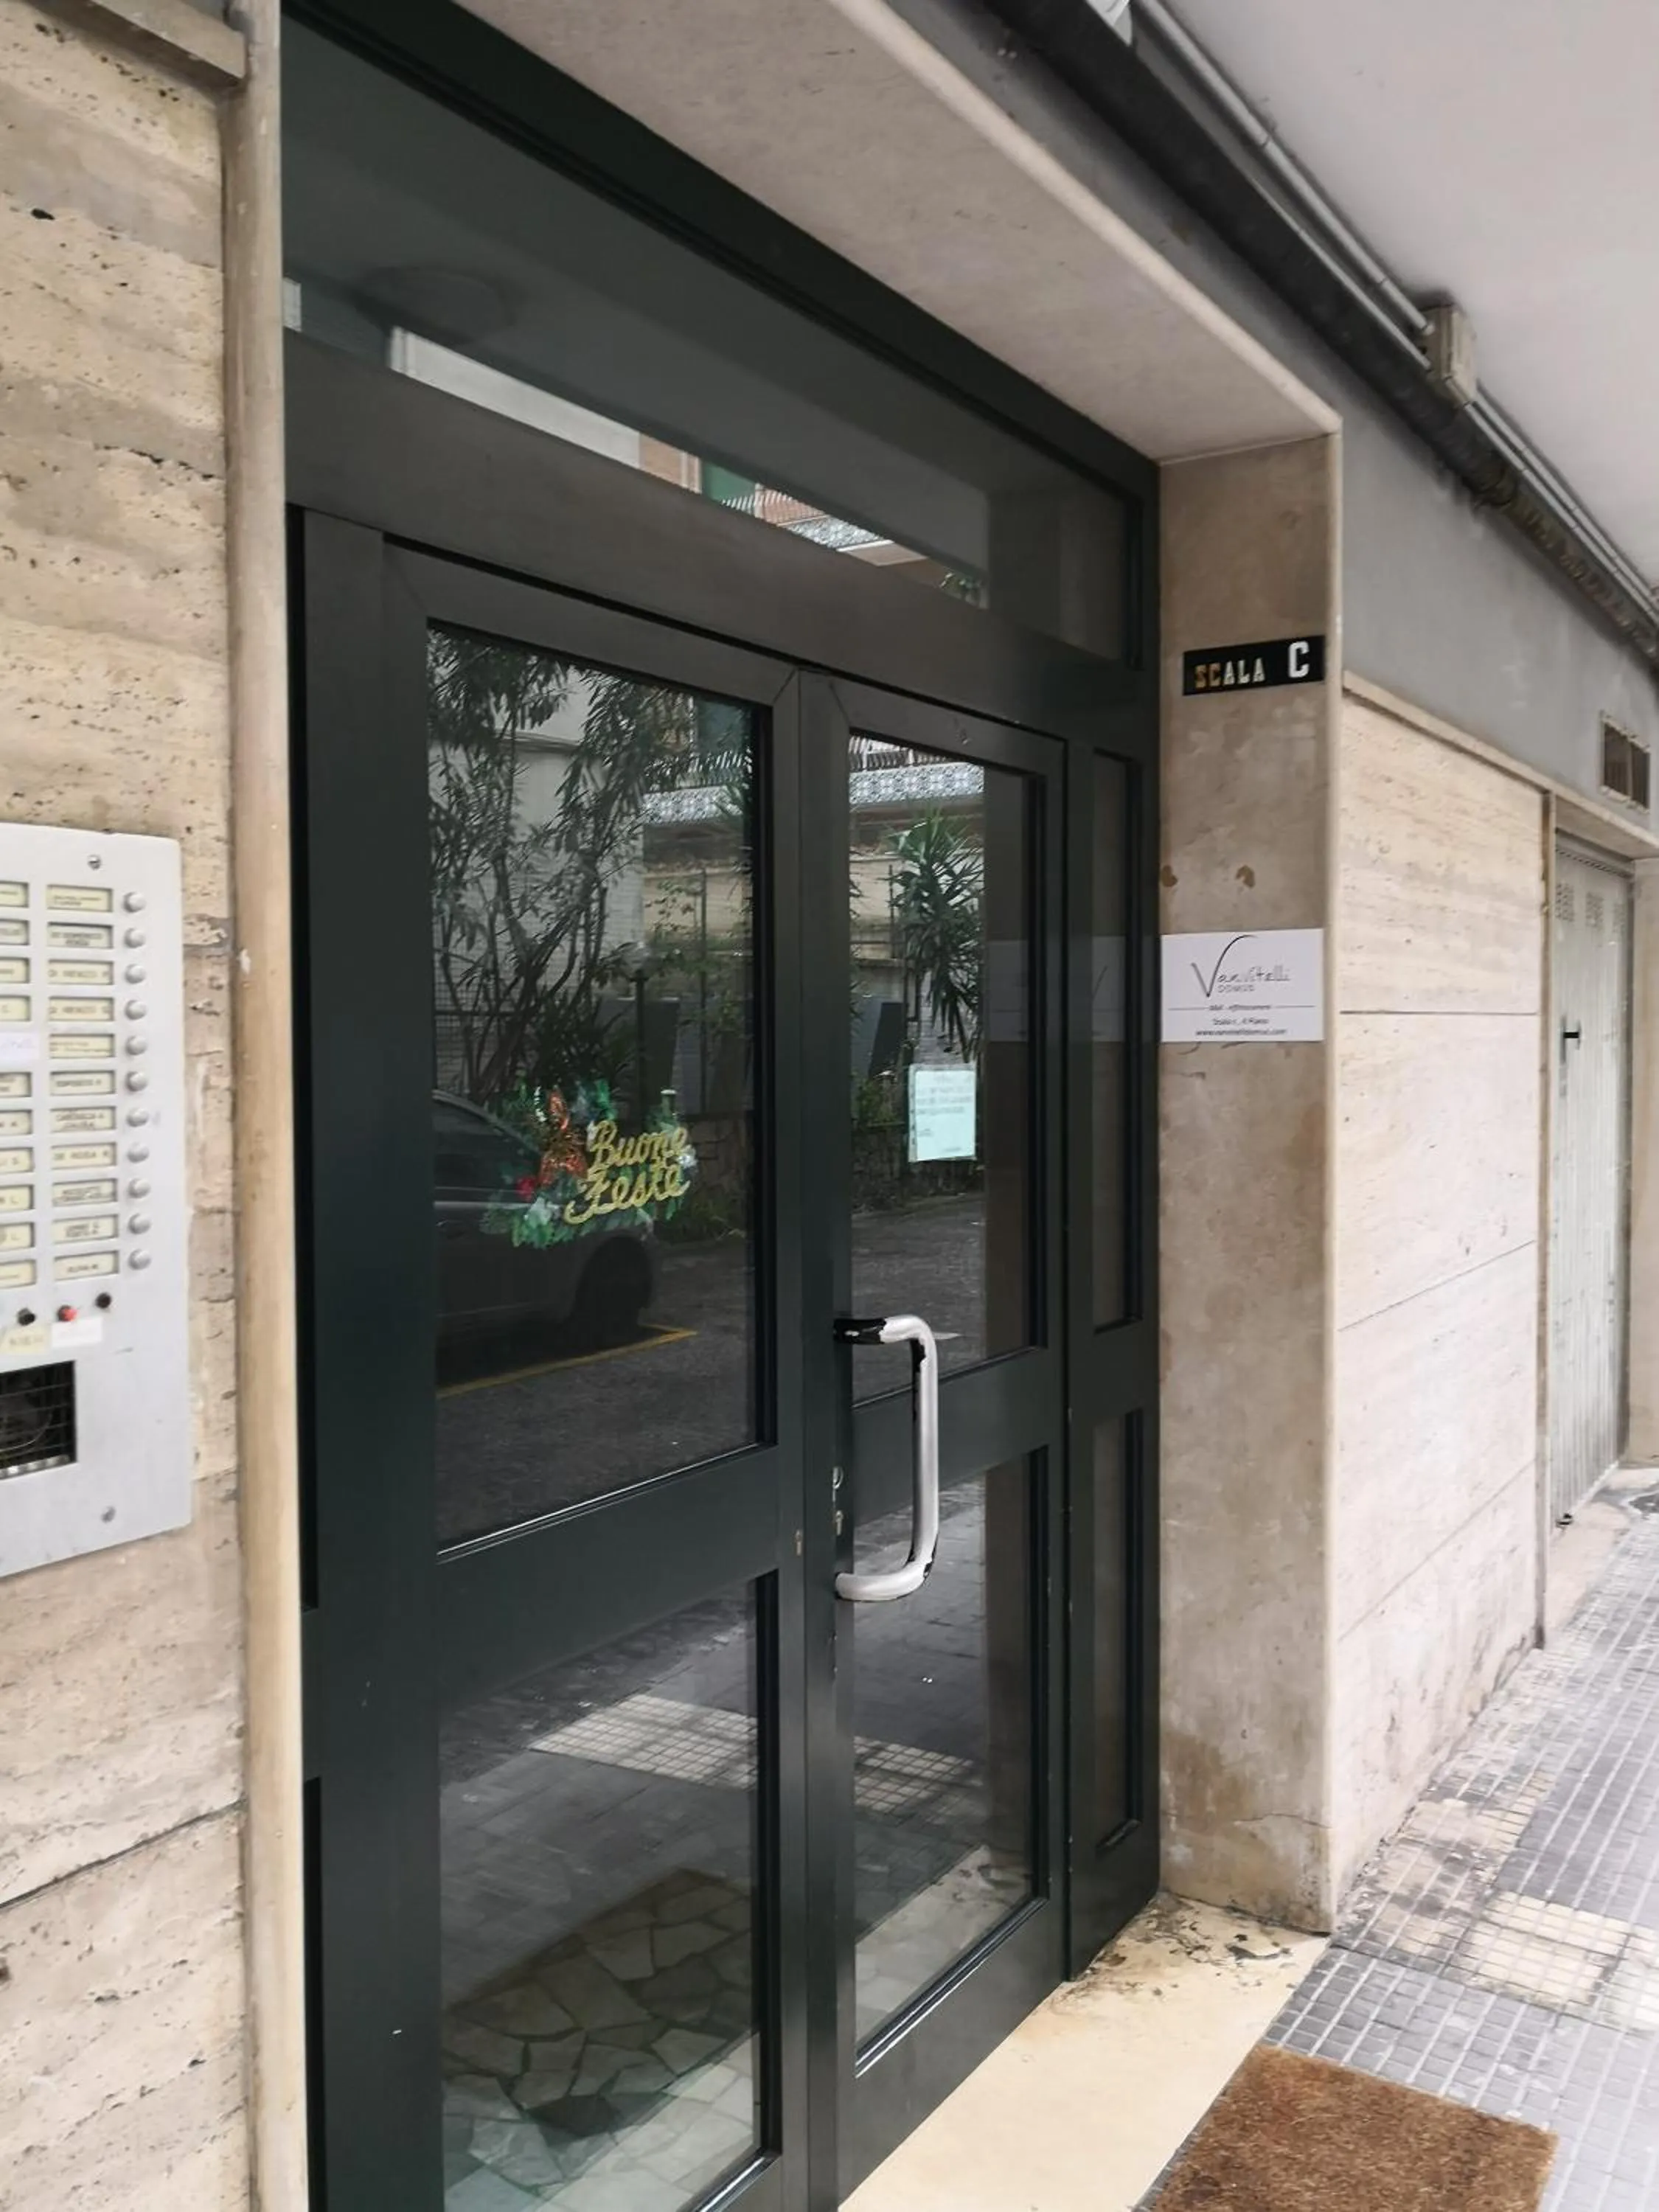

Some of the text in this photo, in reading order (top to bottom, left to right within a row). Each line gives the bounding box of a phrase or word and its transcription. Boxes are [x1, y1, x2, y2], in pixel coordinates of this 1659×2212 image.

[1194, 640, 1310, 689] SCALA C
[587, 1120, 689, 1168] Buone
[563, 1157, 692, 1225] Feste
